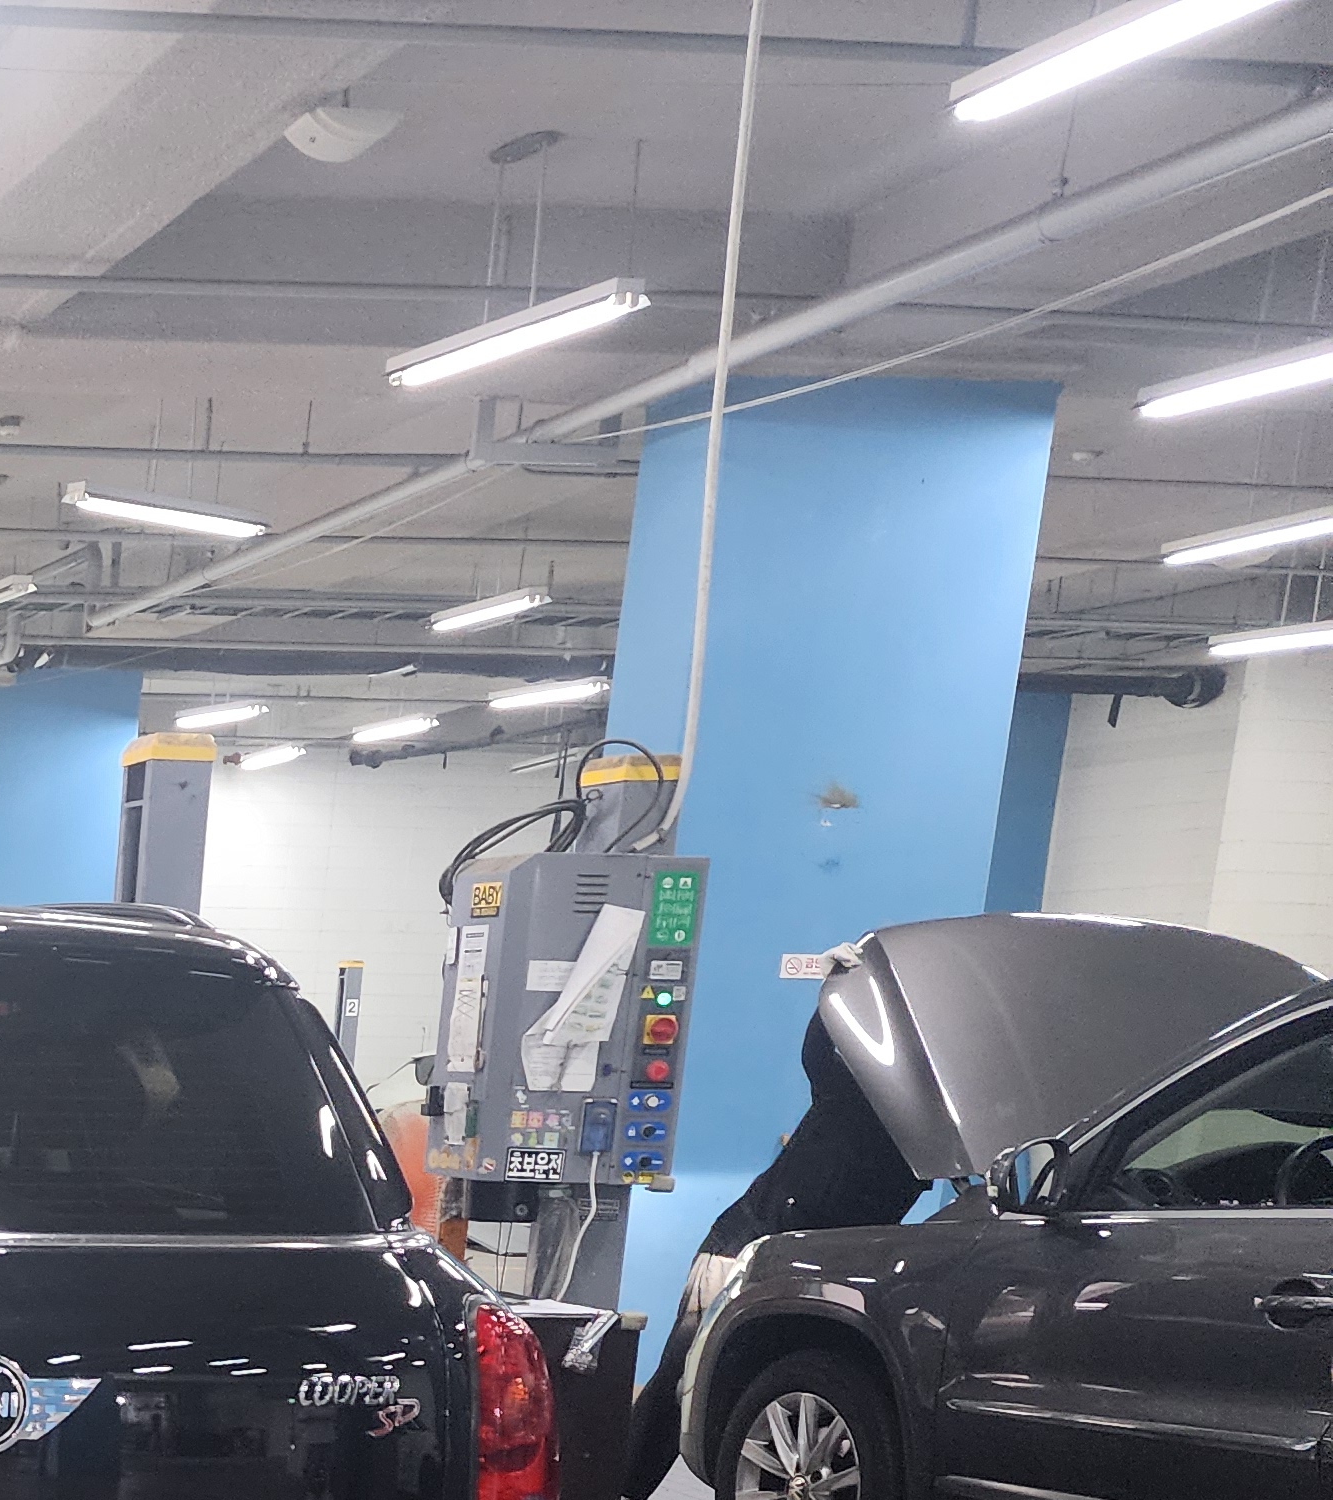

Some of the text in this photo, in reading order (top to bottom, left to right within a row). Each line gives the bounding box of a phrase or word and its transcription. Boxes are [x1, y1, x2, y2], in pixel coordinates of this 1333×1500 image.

[473, 885, 502, 906] BABY
[348, 1001, 356, 1013] 2
[507, 1151, 562, 1180] 초보운전
[299, 1374, 400, 1406] COOPER
